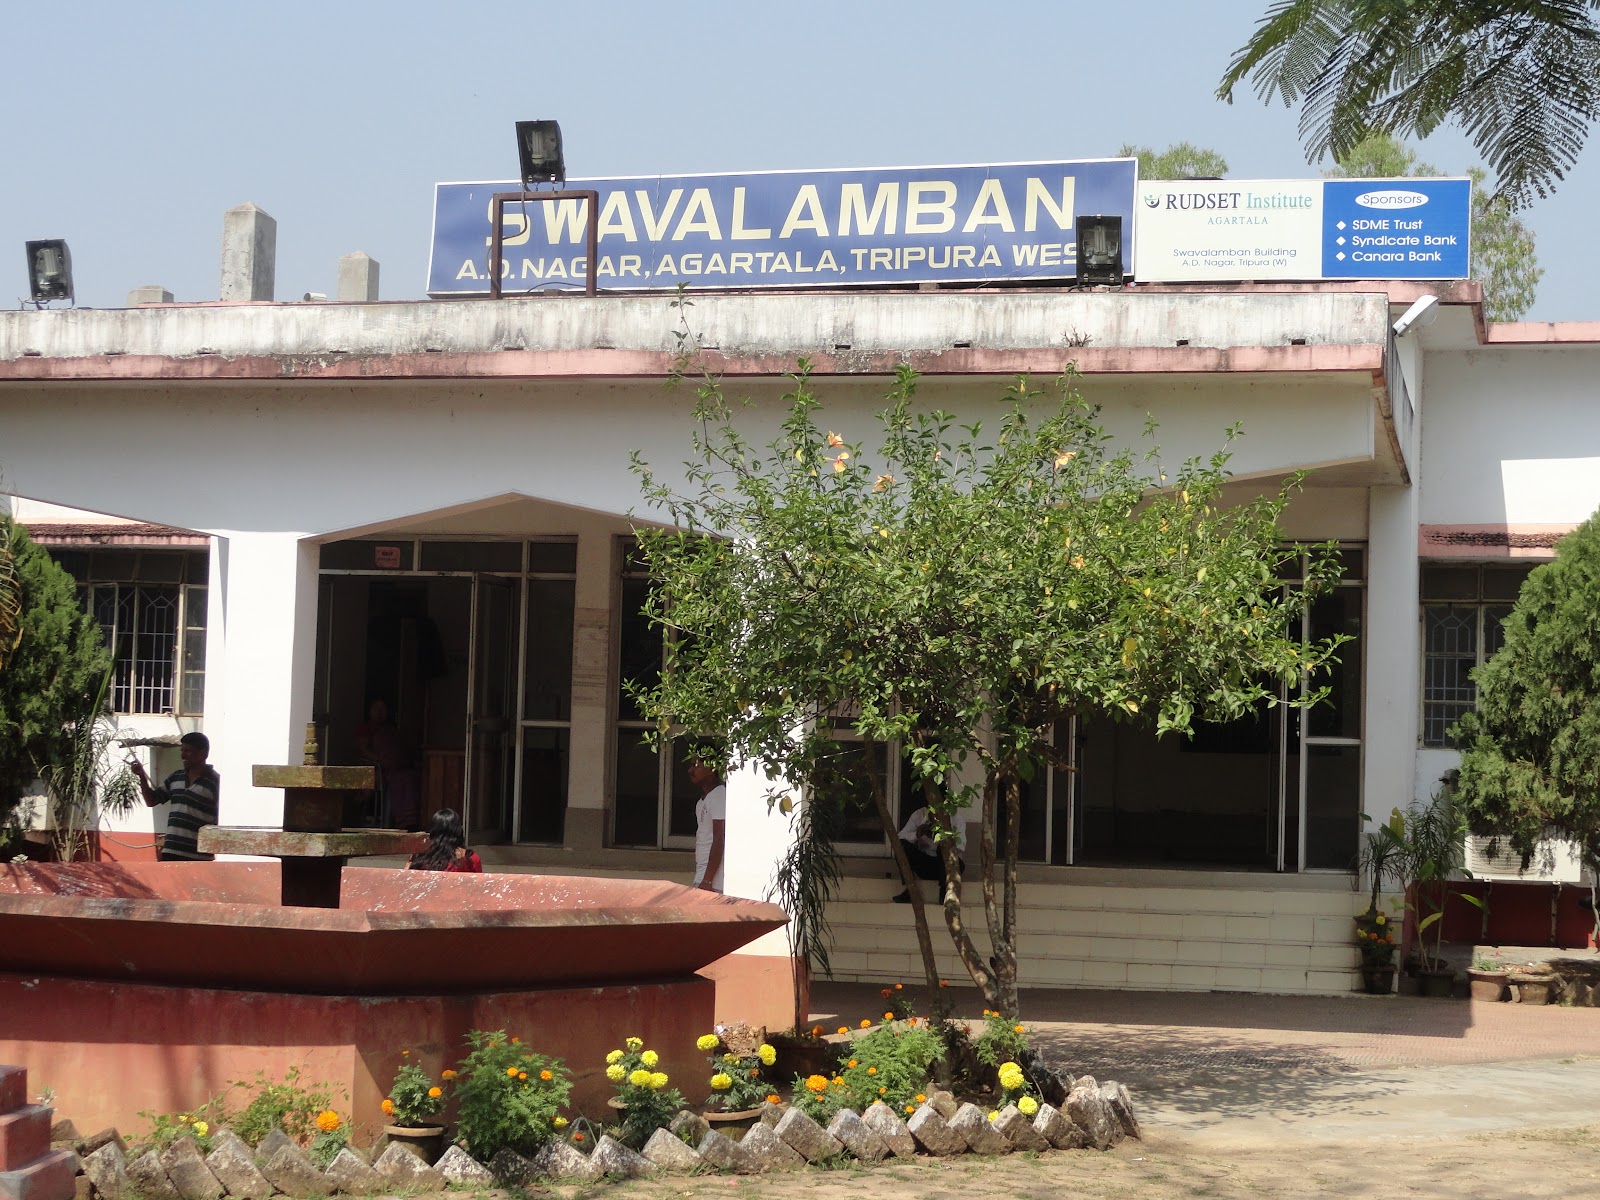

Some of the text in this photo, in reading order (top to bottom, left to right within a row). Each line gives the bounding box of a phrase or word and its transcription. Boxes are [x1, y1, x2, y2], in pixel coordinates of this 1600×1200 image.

[1165, 192, 1313, 210] RUDSET Institute
[1362, 194, 1422, 206] Sponsors
[485, 176, 1075, 246] SWAVALAMBAN
[1207, 216, 1269, 225] AGARTALA
[1352, 219, 1423, 230] SDME Trust
[1351, 235, 1457, 248] Syndicate Bank
[1172, 248, 1297, 258] Swavalamban Building
[1351, 251, 1442, 262] Canara Bank
[521, 255, 651, 280] NAGAR,
[655, 250, 846, 276] AGARTALA,
[850, 244, 1003, 271] TRIPURA
[1181, 258, 1287, 268] A.D. Nagar, Tripura (W)
